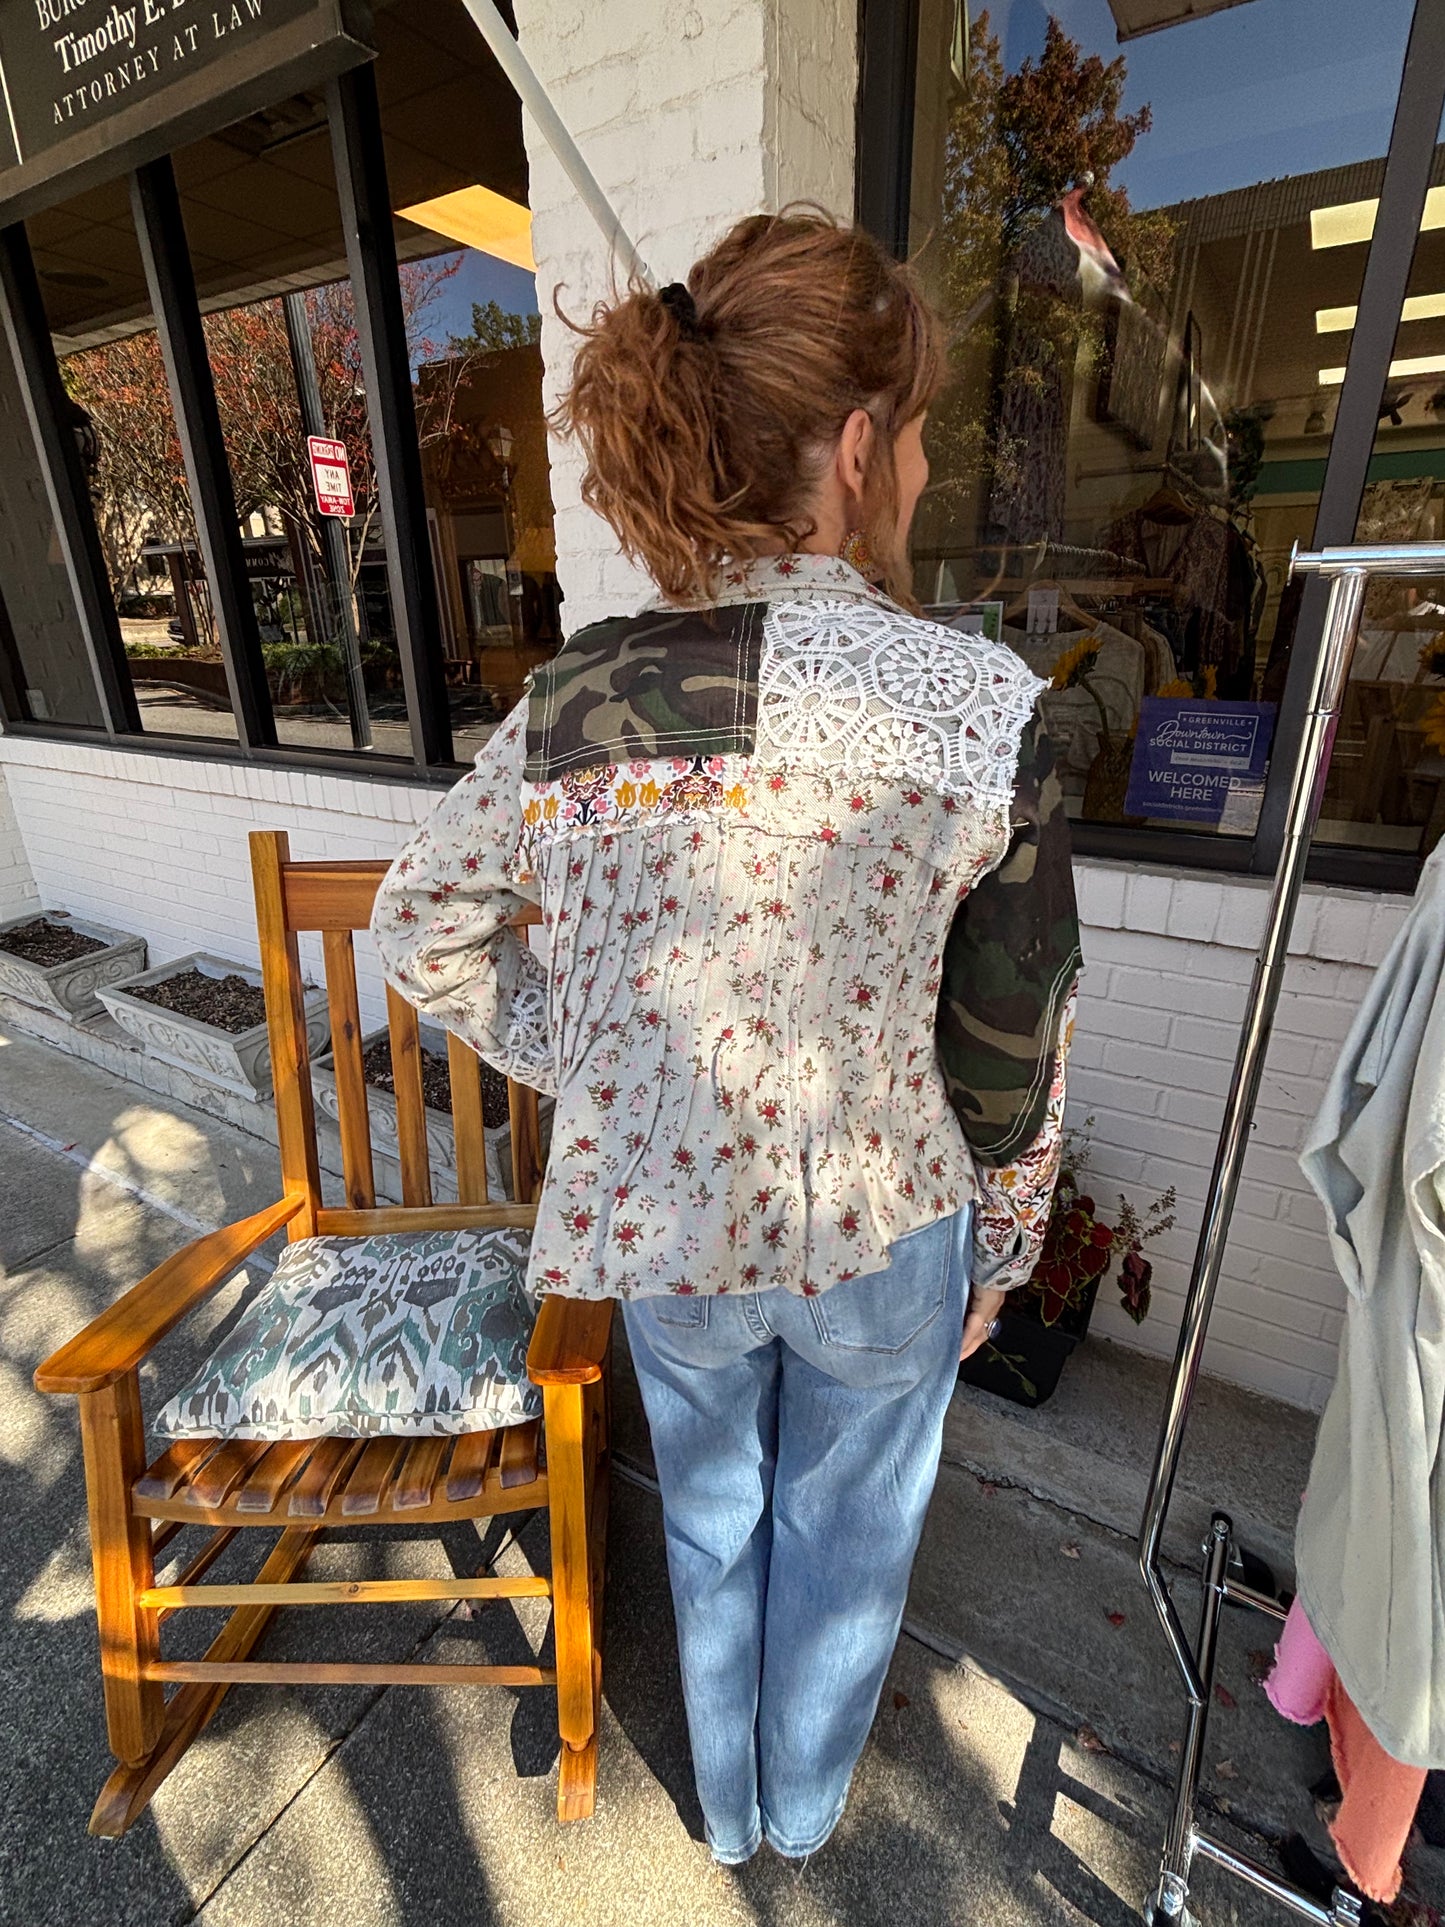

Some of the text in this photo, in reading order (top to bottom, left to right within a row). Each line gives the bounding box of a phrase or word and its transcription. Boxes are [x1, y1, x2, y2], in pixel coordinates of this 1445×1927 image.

[53, 0, 166, 74] Timothy E.
[53, 0, 263, 125] ATTORNEY AT LAW
[1156, 719, 1252, 742] Downtown
[1188, 717, 1246, 726] GREENVILLE
[1150, 738, 1247, 752] SOCIAL DISTRICT
[1148, 770, 1242, 790] WELCOMED
[1170, 787, 1213, 801] HERE
